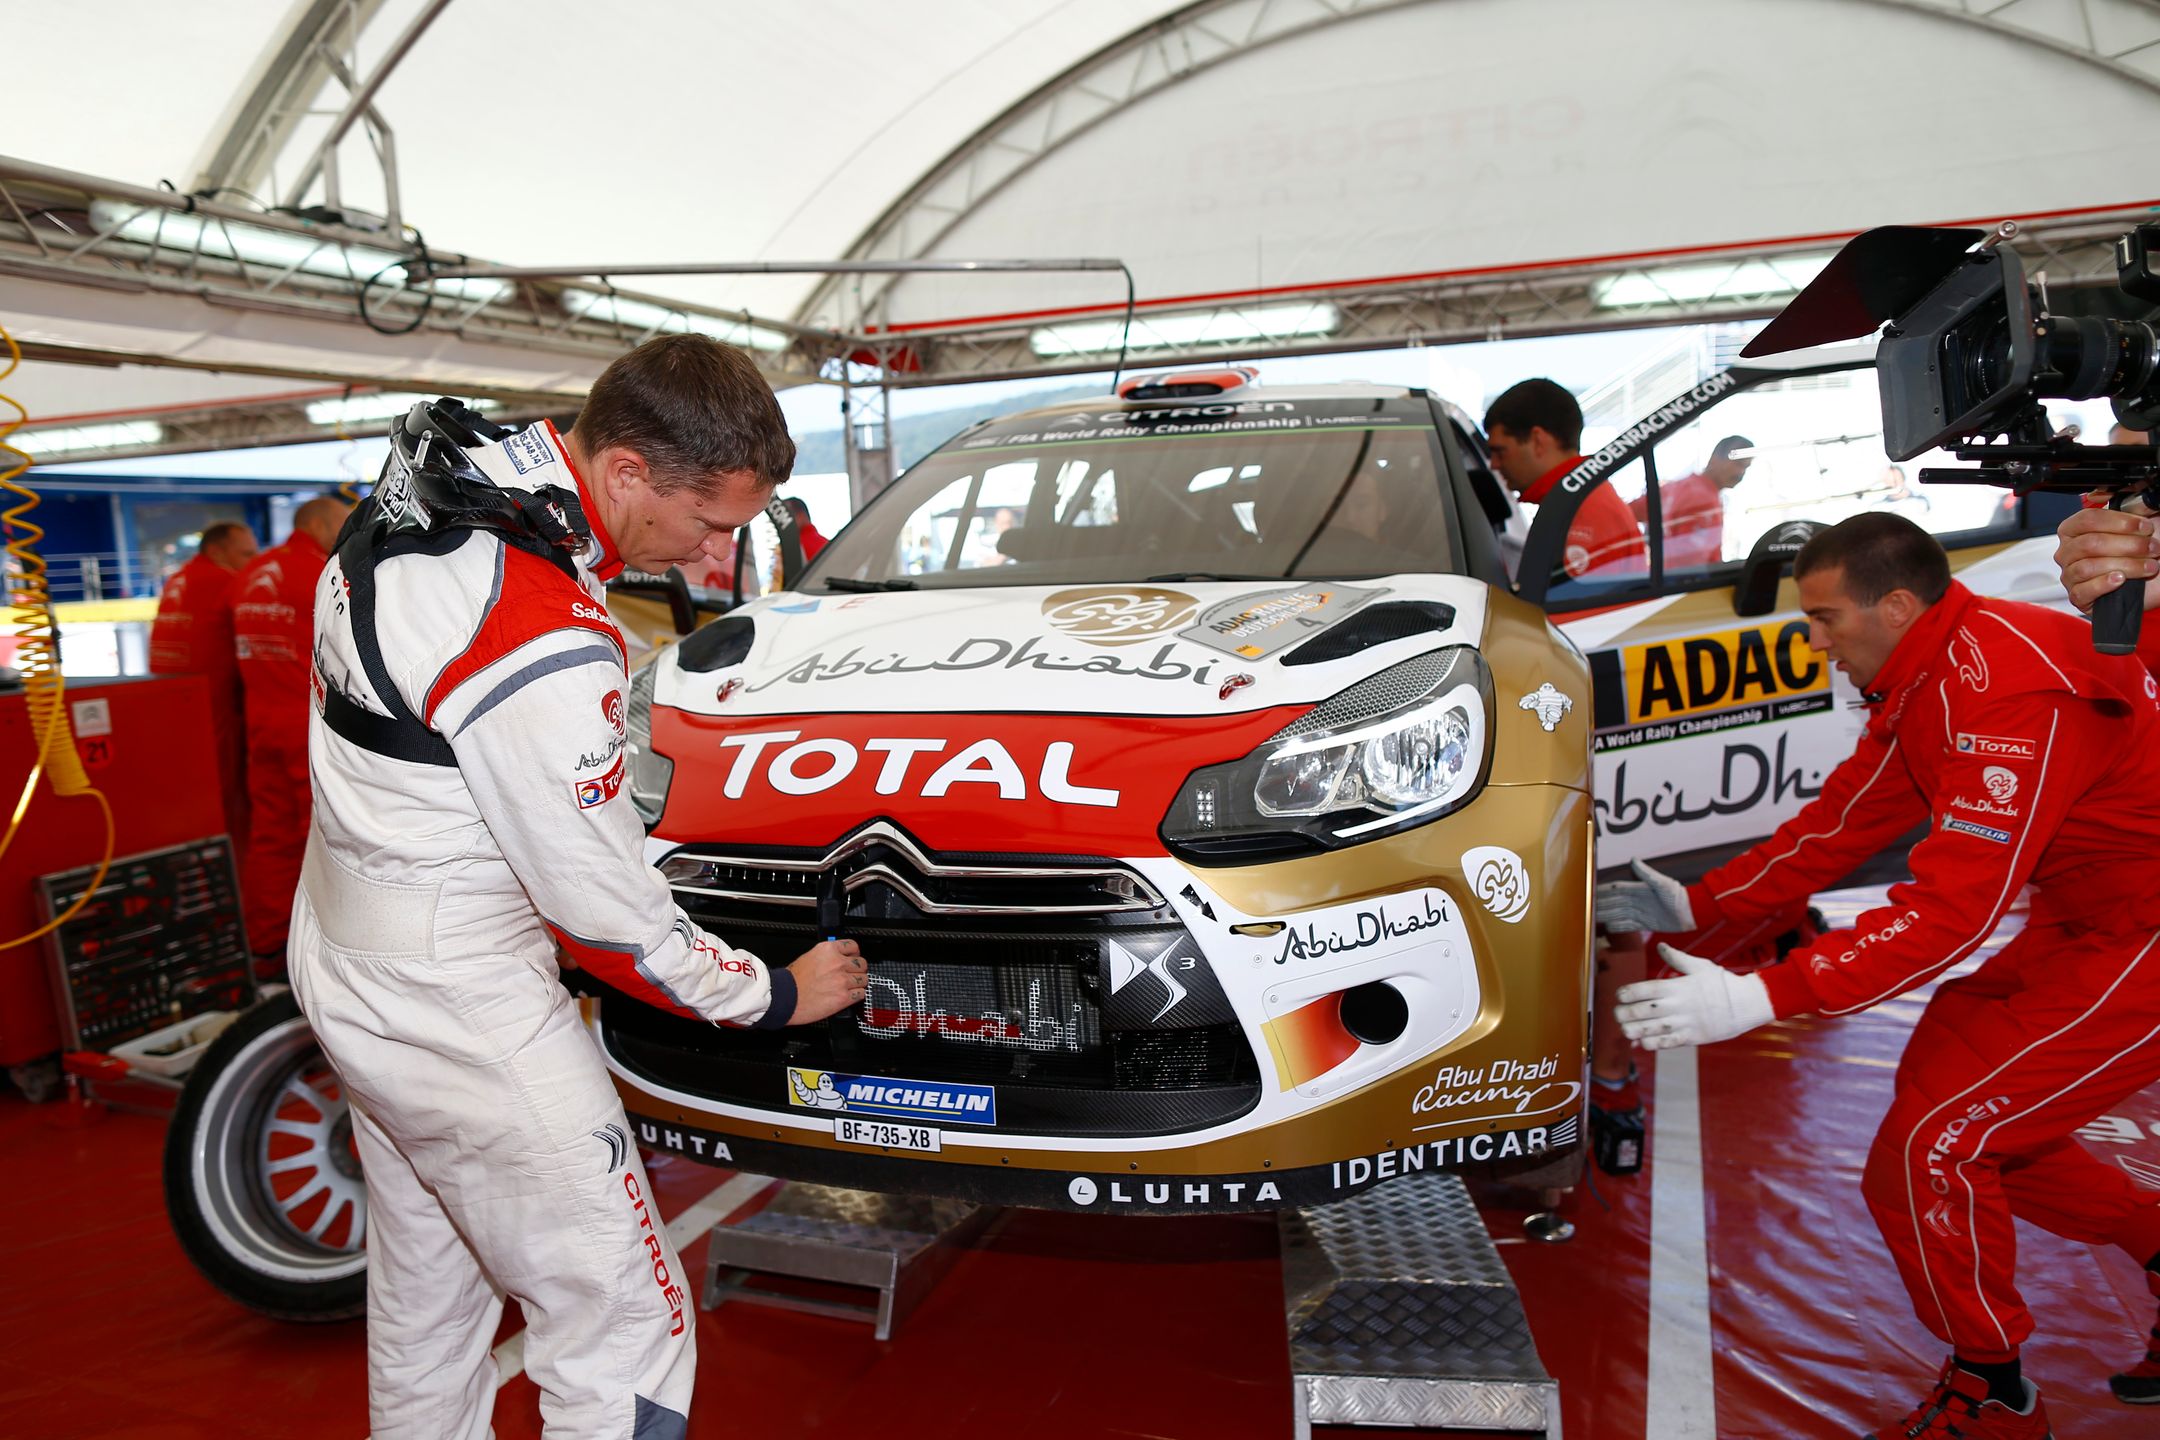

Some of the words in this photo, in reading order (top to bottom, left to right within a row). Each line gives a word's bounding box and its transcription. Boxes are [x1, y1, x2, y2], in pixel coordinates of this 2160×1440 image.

[1008, 433, 1038, 444] FIA
[1041, 428, 1096, 442] World
[1100, 426, 1150, 438] Rally
[1154, 416, 1301, 434] Championship
[1562, 372, 1736, 493] CITROENRACING.COM
[385, 490, 403, 514] PRO
[1208, 612, 1260, 635] ADAC
[1250, 591, 1312, 618] RALLYE
[1295, 616, 1328, 629] 4
[1638, 621, 1820, 718] ADAC
[1606, 730, 1643, 749] World
[1646, 723, 1678, 740] Rally
[1679, 708, 1763, 735] Championship
[85, 741, 109, 763] 21
[1978, 740, 2033, 755] TOTAL
[720, 731, 1120, 807] TOTAL
[1951, 821, 2008, 840] MICHELIN
[1434, 1064, 1485, 1091] Abu
[1487, 1053, 1560, 1083] Dhabi
[847, 1083, 990, 1112] MICHELIN
[1412, 1083, 1552, 1115] Racing
[632, 1122, 734, 1162] UHTA
[842, 1121, 931, 1148] BF-735-XB
[1332, 1126, 1549, 1190] IDENTICAR
[1110, 1181, 1282, 1204] LUHTA
